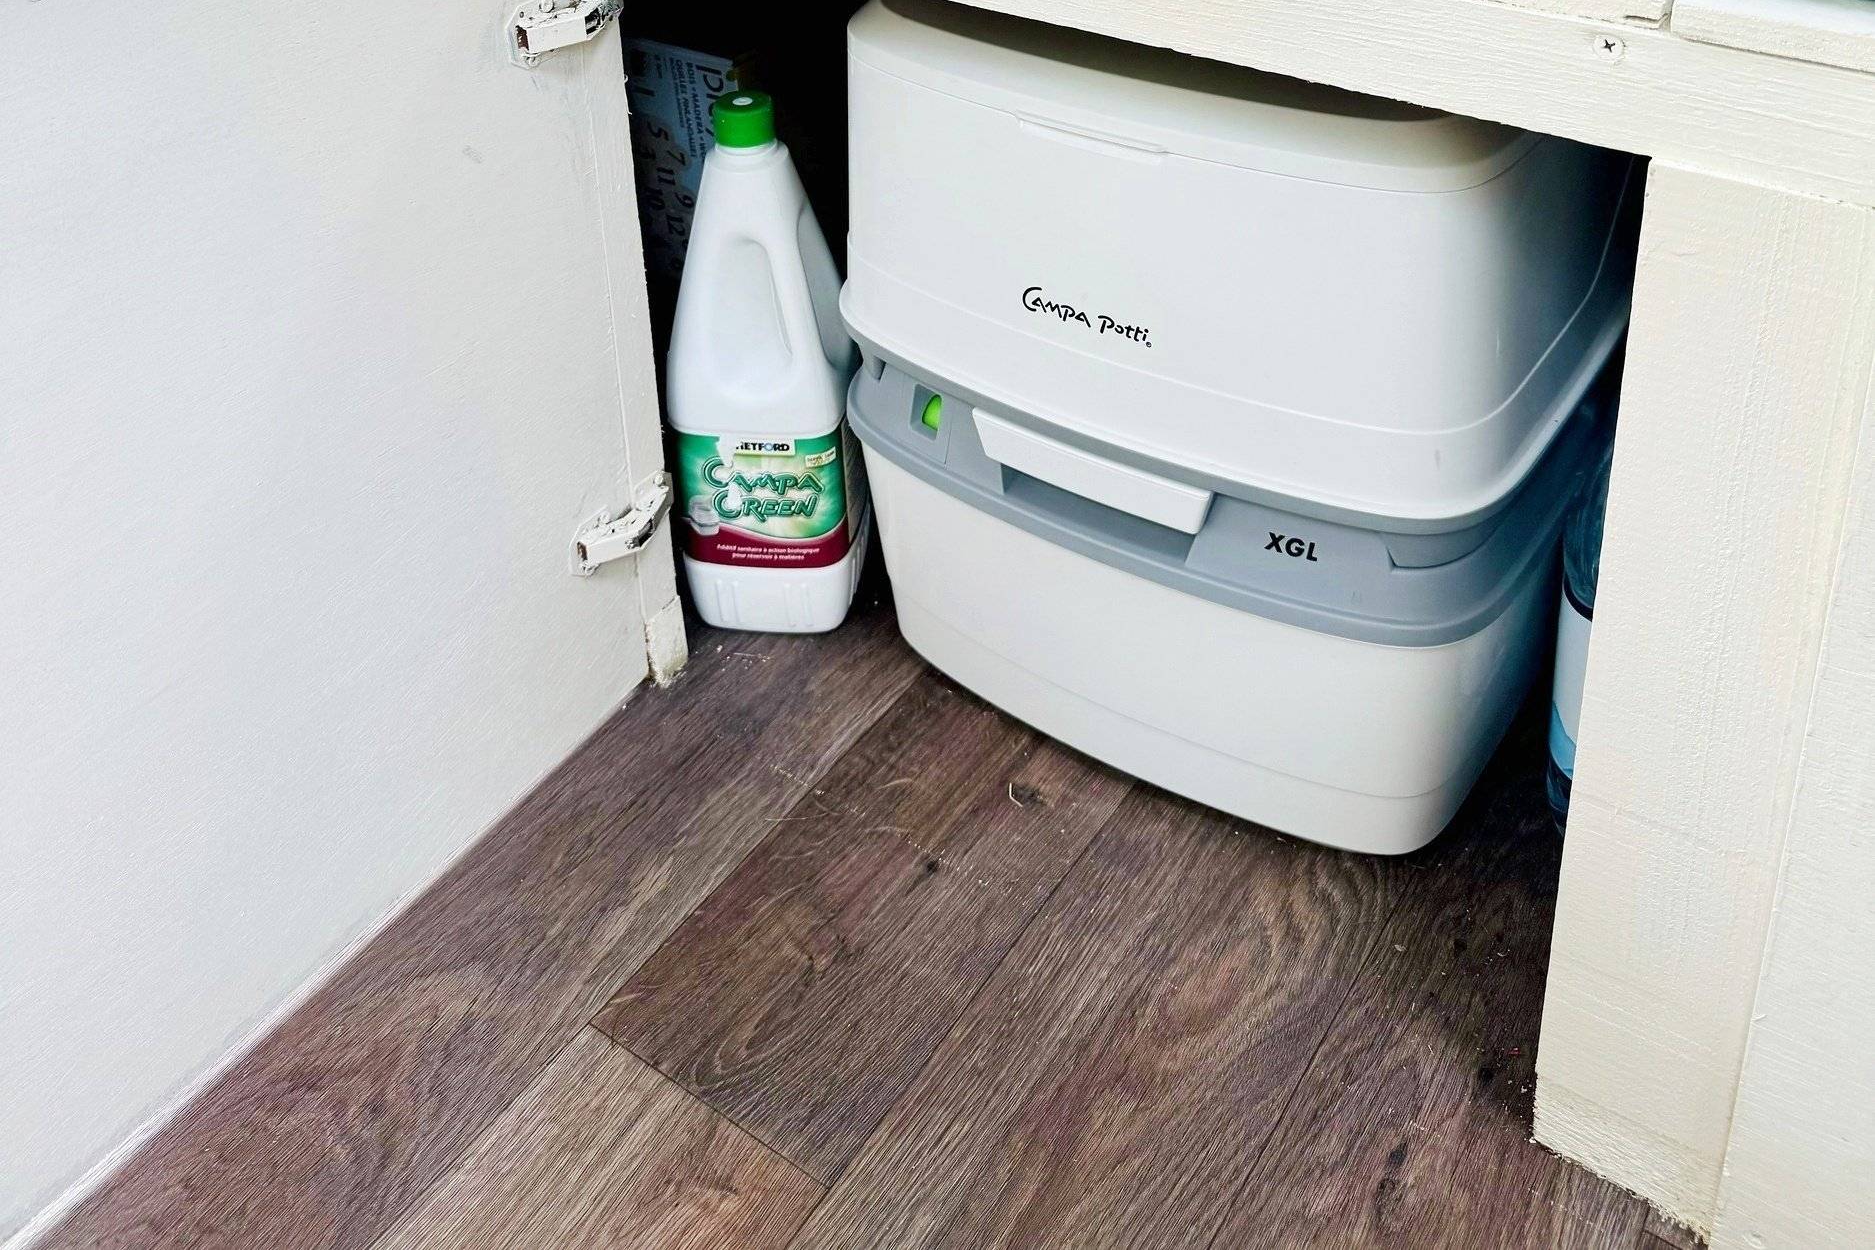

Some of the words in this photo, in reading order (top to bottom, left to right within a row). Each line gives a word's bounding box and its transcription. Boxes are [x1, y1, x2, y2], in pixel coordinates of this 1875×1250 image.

[736, 441, 790, 452] ETFORD
[703, 456, 825, 495] CAMPA
[1263, 531, 1318, 562] XGL
